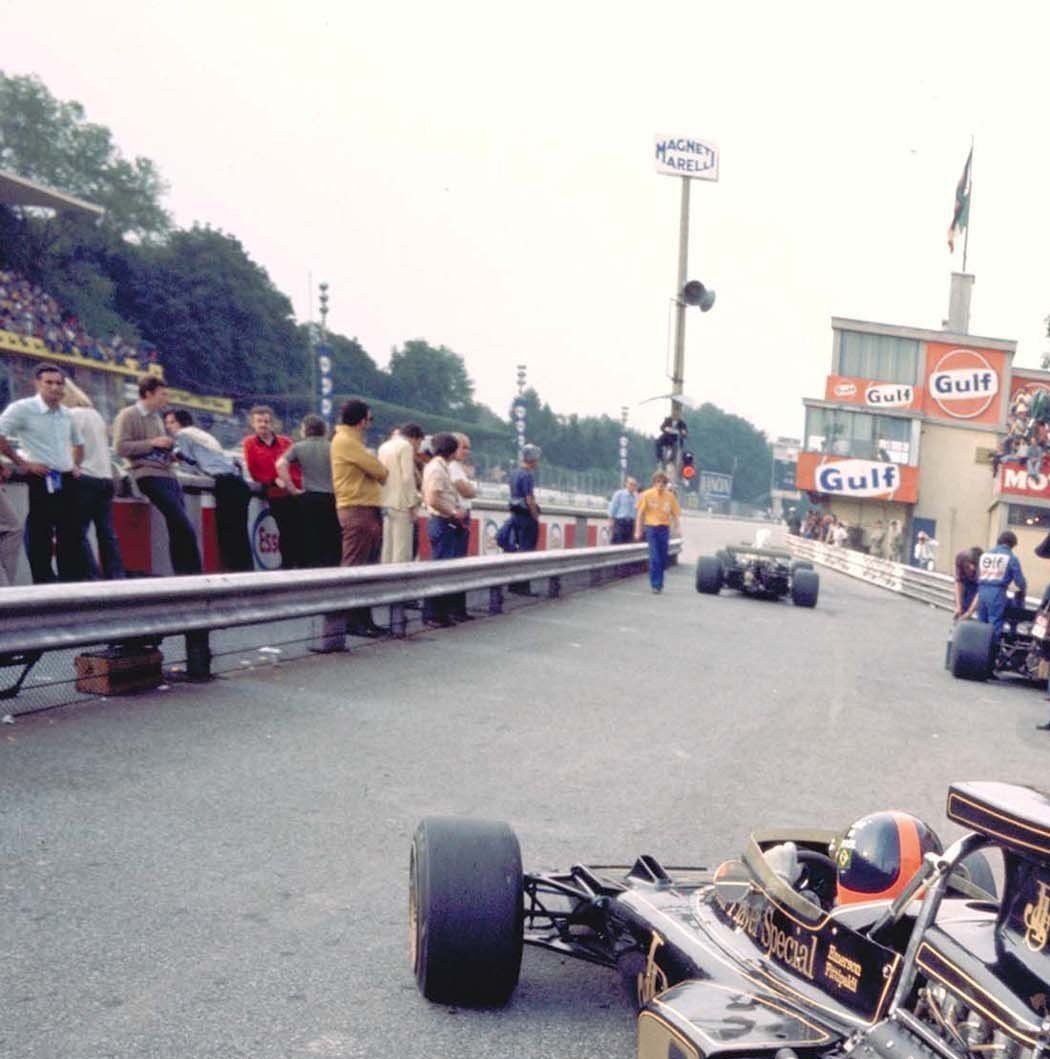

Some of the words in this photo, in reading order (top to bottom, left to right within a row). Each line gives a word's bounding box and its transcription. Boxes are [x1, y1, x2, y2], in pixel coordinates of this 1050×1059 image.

[935, 373, 992, 394] Gulf
[867, 389, 911, 404] Gulf
[820, 467, 896, 491] Gulf
[982, 556, 1003, 569] elf
[761, 908, 818, 980] Special
[828, 944, 862, 978] Emerson
